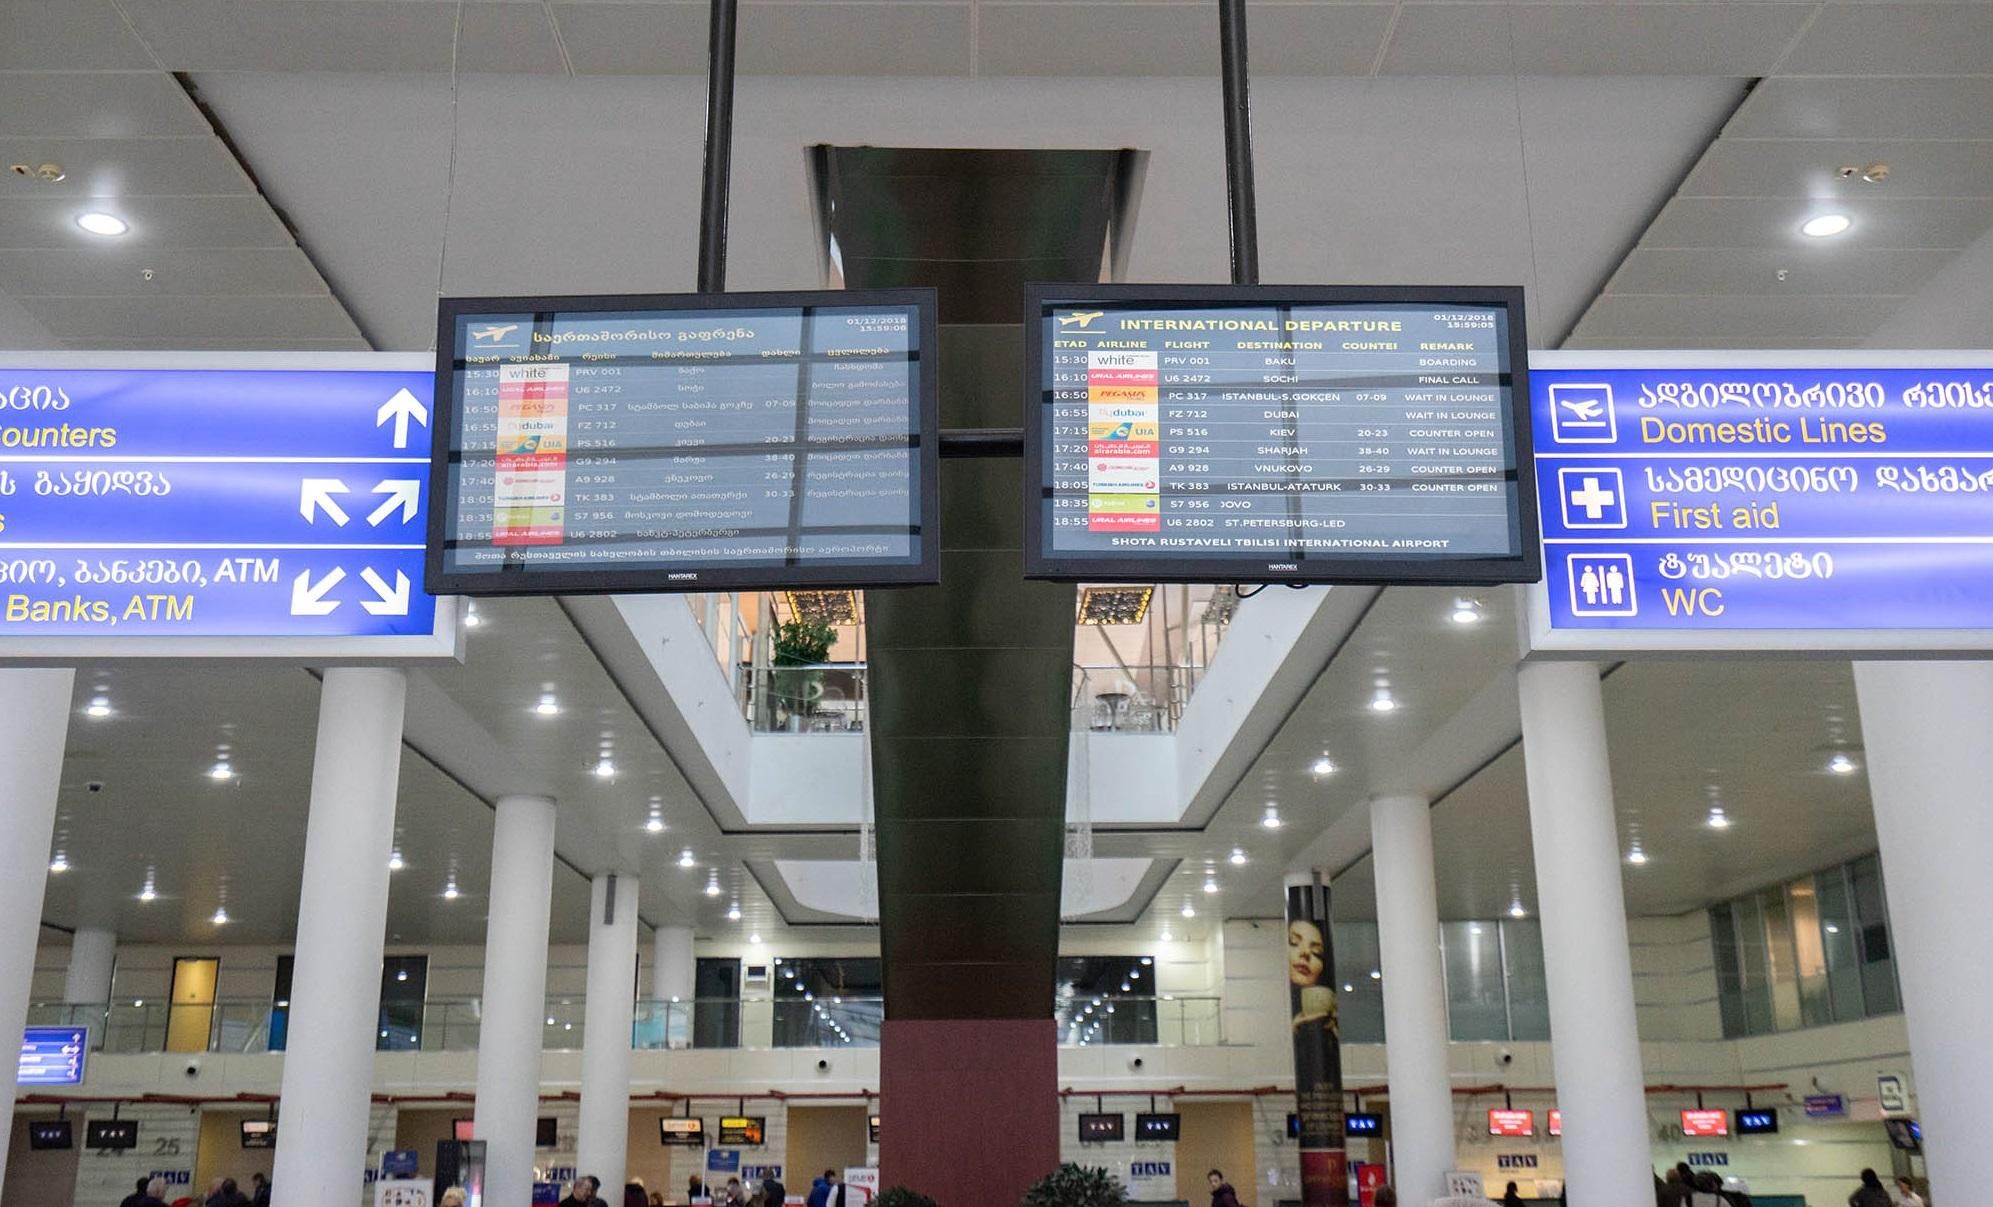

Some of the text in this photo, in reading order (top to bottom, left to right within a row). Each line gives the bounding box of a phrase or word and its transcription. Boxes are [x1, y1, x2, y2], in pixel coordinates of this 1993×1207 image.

[1120, 320, 1401, 331] INTERNATIONAL DEPARTURE
[534, 330, 754, 343] საერთაშორისო გაფრენა
[1054, 356, 1087, 364] 15:30
[1098, 355, 1135, 365] white
[1165, 357, 1210, 365] PRV 001
[467, 370, 499, 378] 15:30
[510, 368, 546, 378] white
[1054, 374, 1087, 382] 16:10
[1264, 375, 1298, 383] SOCHI
[1419, 376, 1479, 384] FINAL CALL
[466, 388, 498, 396] 16:10
[595, 385, 621, 393] 2472
[1639, 383, 1885, 409] ადგილობრივი
[465, 406, 497, 414] 16:50
[597, 403, 616, 411] 317
[1054, 409, 1088, 417] 16:55
[1188, 410, 1207, 418] 712
[1264, 410, 1299, 418] DUBAI
[1451, 412, 1496, 420] LOUNGE
[464, 423, 496, 432] 16:55
[596, 421, 616, 429] 712
[1270, 428, 1295, 436] KIEV
[1641, 417, 1886, 443] Domestic Lines
[463, 441, 496, 449] 17:15
[1189, 446, 1209, 454] 294
[1258, 447, 1308, 455] SHARJAH
[1188, 464, 1209, 472] 928
[1255, 465, 1313, 473] VNUKOVO
[34, 470, 171, 496] გაყიდვა
[462, 478, 494, 486] 17:40
[1645, 466, 1857, 492] სამედიცინო
[1188, 482, 1209, 490] 383
[1228, 483, 1341, 491] ISTANBUL-ATATURK
[1412, 484, 1497, 492] COUNTER OPEN
[461, 496, 493, 504] 18:05
[595, 494, 614, 502] 383
[460, 514, 492, 522] 18:35
[593, 512, 613, 520] 956
[1651, 502, 1779, 528] First aid
[1055, 518, 1088, 526] 18:55
[1167, 519, 1214, 527] U6 2802
[1225, 519, 1345, 528] ST.PETERSBURG-LED
[459, 532, 492, 541] 18:55
[1112, 538, 1449, 548] SHOTA RUSTAVELI TBILISI INTERNATIONAL AIRPORT
[1658, 552, 1832, 578] ტუალეტი
[75, 560, 207, 586] ბანკები,
[214, 559, 279, 581] ATM
[1662, 588, 1725, 616] WC
[6, 596, 193, 625] Banks, ATM
